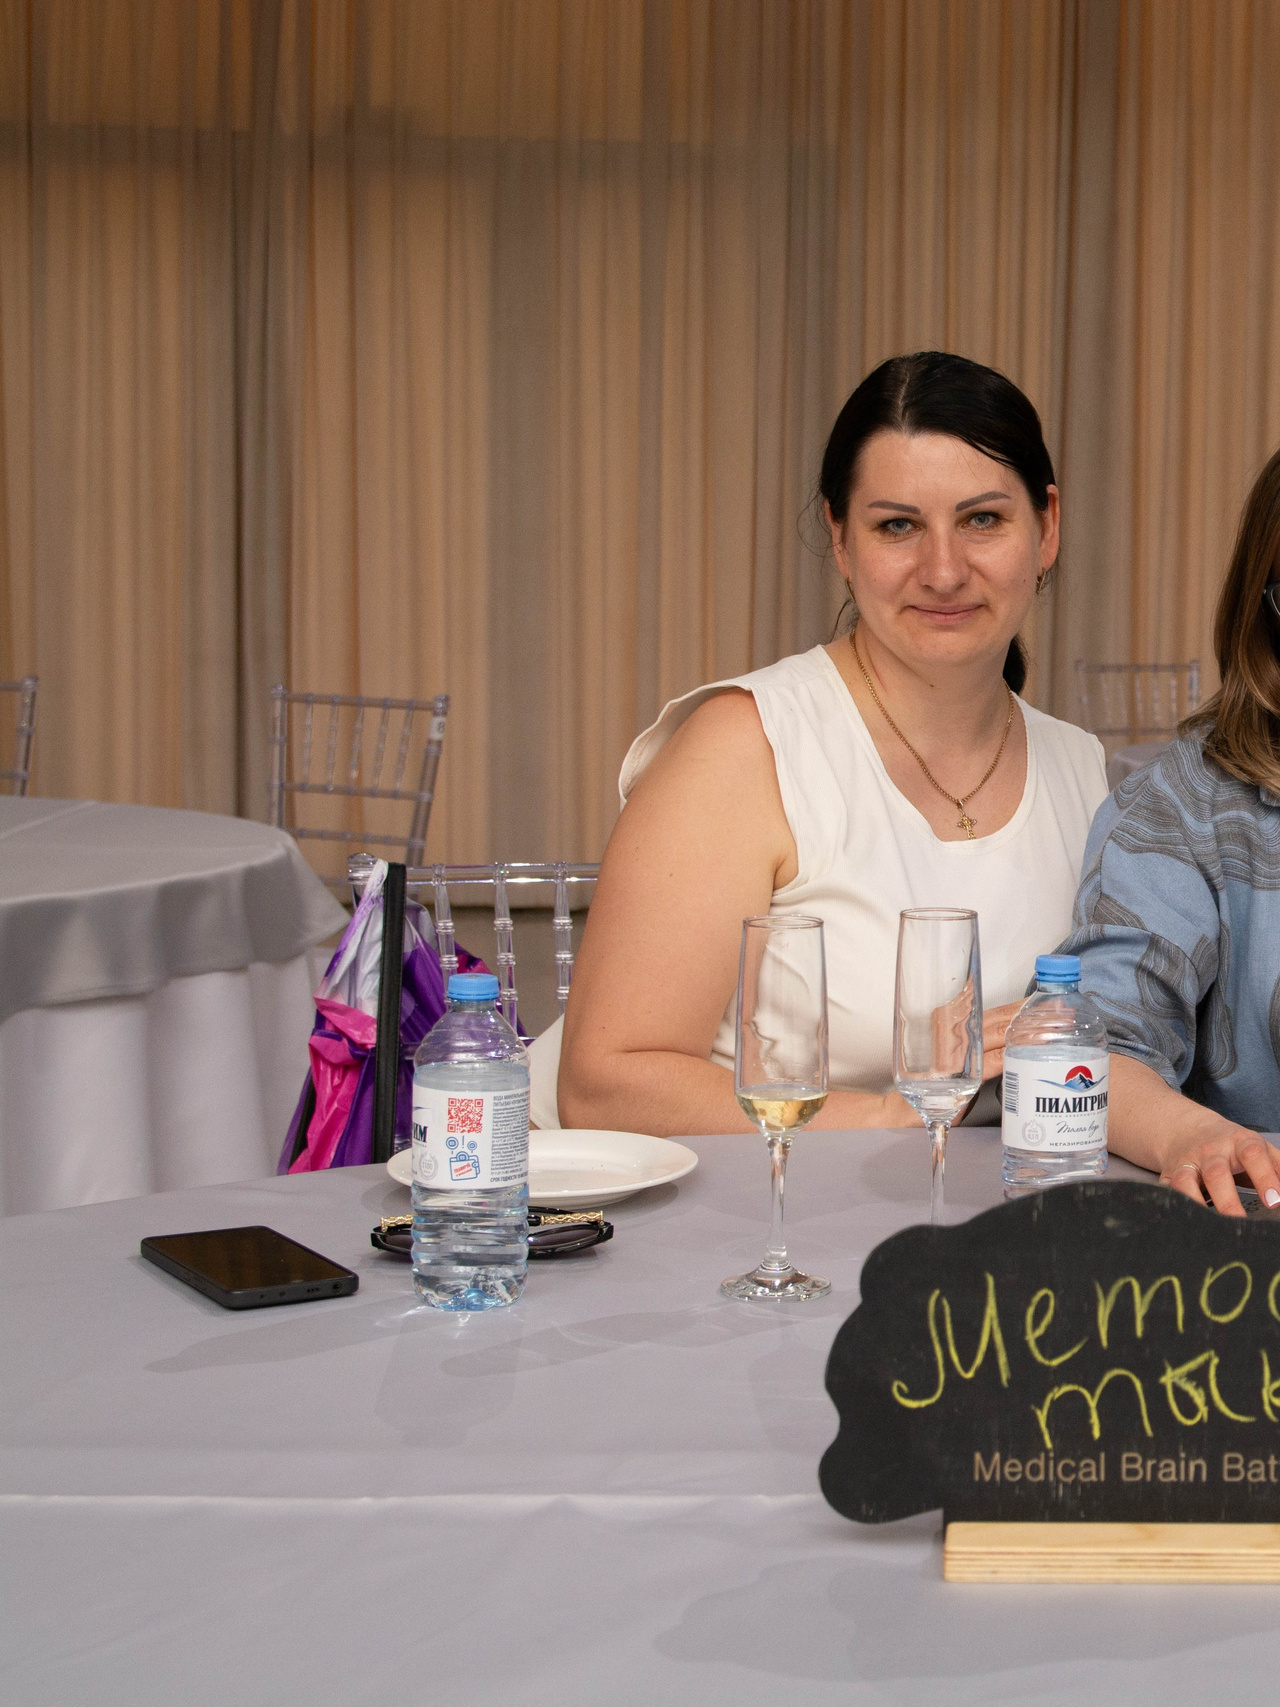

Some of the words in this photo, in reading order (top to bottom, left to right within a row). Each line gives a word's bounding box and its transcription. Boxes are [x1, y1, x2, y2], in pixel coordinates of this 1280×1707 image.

[1035, 1090, 1108, 1113] ПИЛИГРИМ
[973, 1451, 1106, 1485] Medical
[1120, 1451, 1208, 1485] Brain
